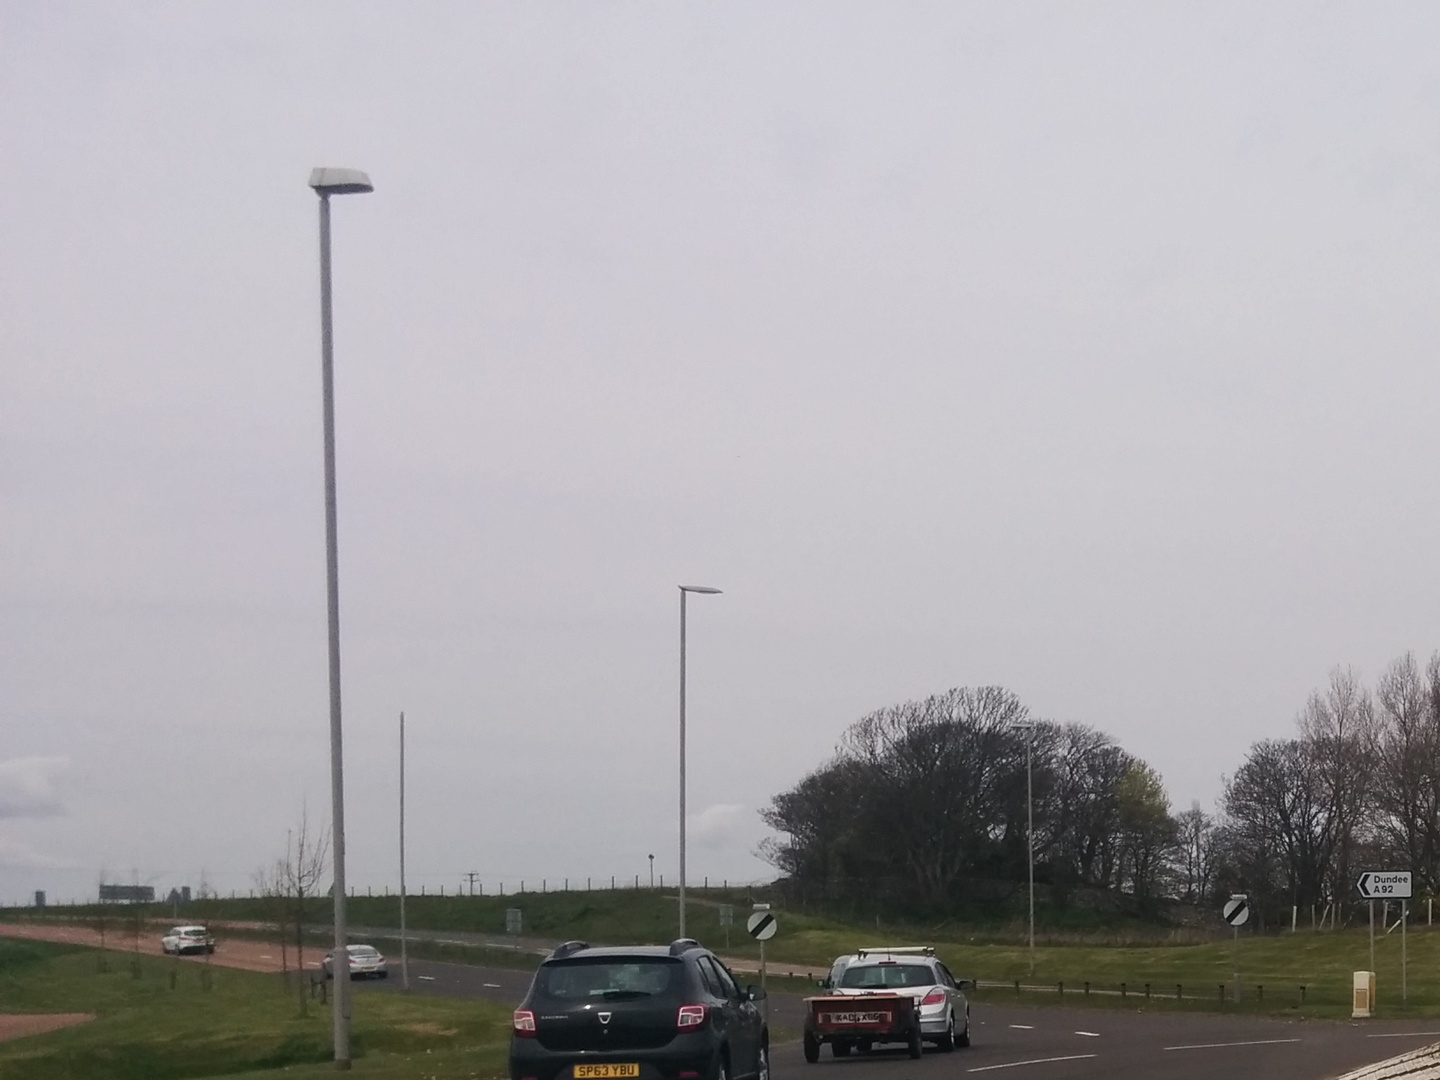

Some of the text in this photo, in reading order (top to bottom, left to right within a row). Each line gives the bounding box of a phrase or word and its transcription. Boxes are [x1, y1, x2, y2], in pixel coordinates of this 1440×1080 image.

[1373, 875, 1409, 884] Dundee
[578, 1064, 635, 1077] SP63 YBU
